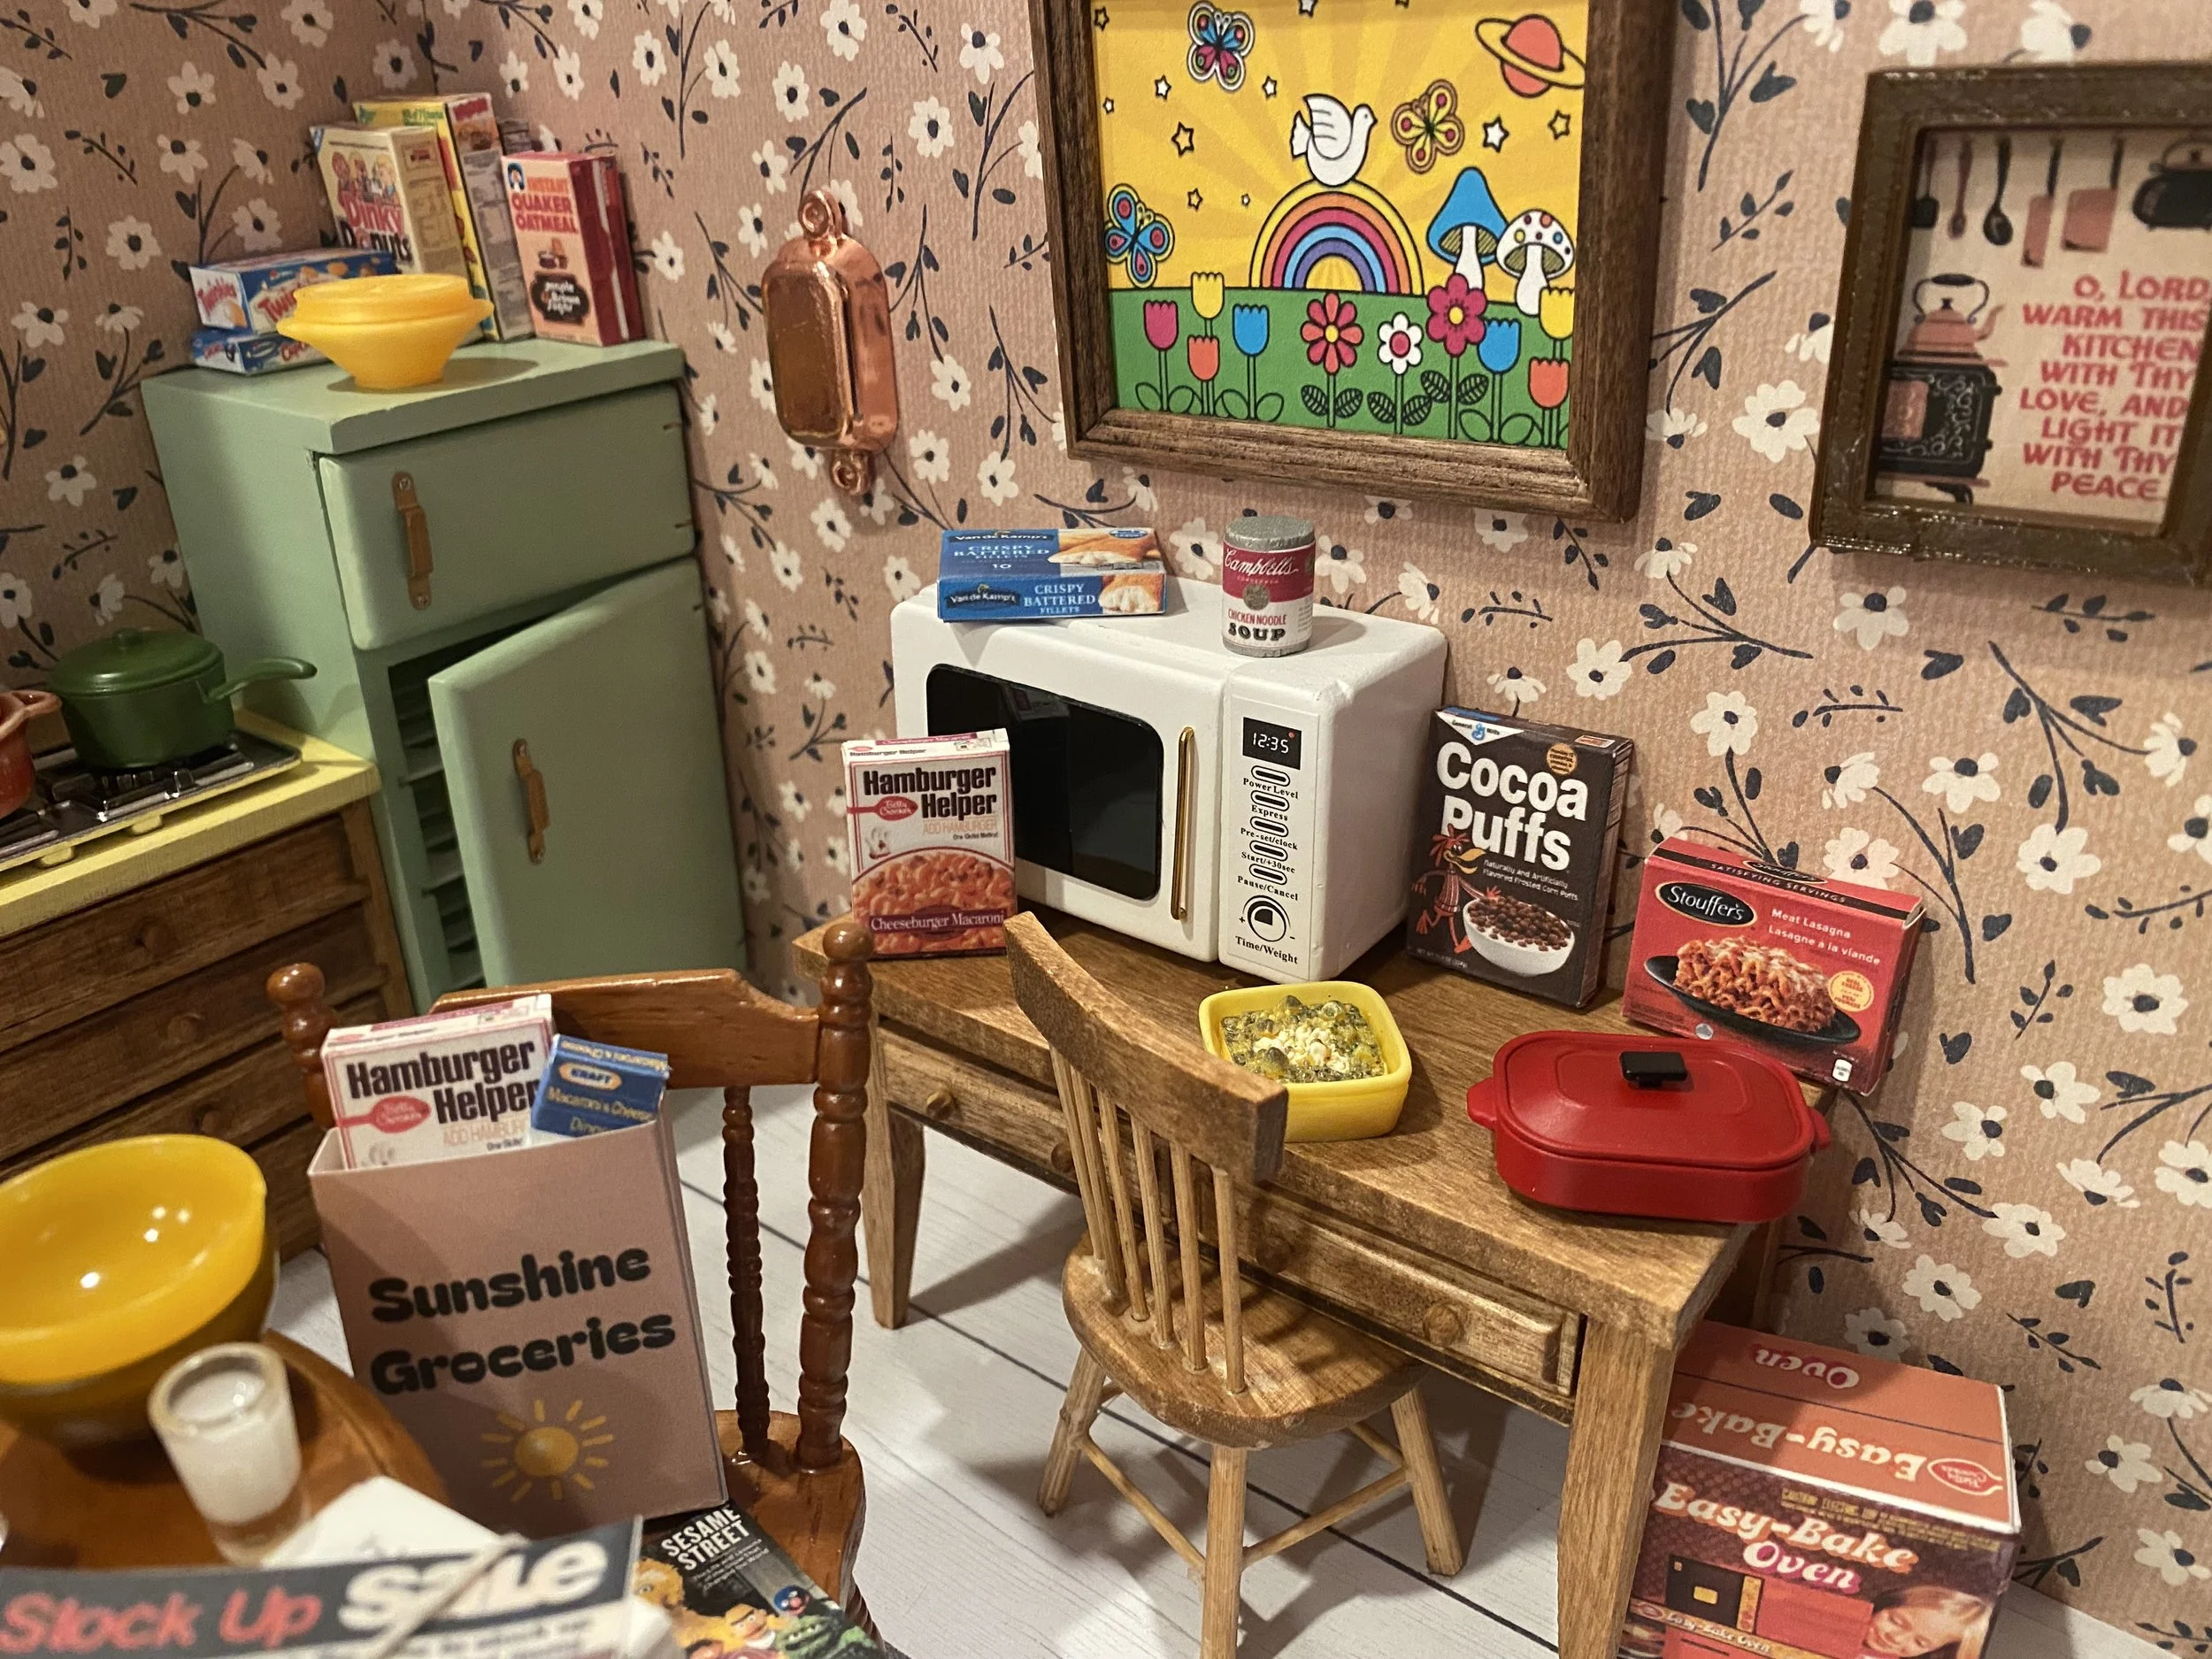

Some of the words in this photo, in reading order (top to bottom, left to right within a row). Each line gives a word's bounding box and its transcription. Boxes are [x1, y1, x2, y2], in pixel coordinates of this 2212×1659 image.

[511, 194, 572, 213] QUAKER
[515, 214, 579, 234] OATMEAL
[2074, 275, 2104, 303] O,
[2120, 270, 2211, 303] LORD,
[2022, 303, 2123, 329] WARM
[2142, 306, 2203, 333] THIS
[2062, 334, 2201, 362] KITCHEN
[2040, 360, 2118, 388] WITH
[2131, 360, 2194, 390] THY
[2020, 388, 2108, 418] LOVE,
[2121, 392, 2190, 419] AND
[2041, 417, 2140, 445] LIGHT
[2150, 422, 2184, 447] IT
[2022, 444, 2101, 470] WITH
[2115, 446, 2176, 475] THY
[2051, 472, 2164, 501] PEACE
[1225, 548, 1299, 576] Campbell's
[951, 594, 970, 603] Van
[1023, 595, 1096, 608] BATTERED
[1033, 584, 1085, 596] CRISPY
[1040, 606, 1080, 615] FILLETS
[1228, 608, 1256, 625] CHICKEN
[1256, 613, 1287, 626] NOODLE
[1227, 622, 1286, 641] SOUP
[1252, 731, 1290, 755] 12:35
[862, 766, 997, 796] Hamburger
[1242, 778, 1272, 794] Power
[1272, 786, 1300, 799] Level
[1436, 741, 1589, 822] Cocoa
[920, 791, 998, 822] Helper
[1250, 803, 1289, 822] Express
[943, 818, 998, 833] HAMBURGER
[1440, 795, 1571, 872] Puffs
[1483, 859, 1516, 874] Naturally
[1516, 867, 1532, 878] and
[1709, 863, 1781, 887] SATISFYING
[1785, 881, 1847, 904] SERVINGS
[1237, 875, 1300, 901] Pause/Cancel
[1514, 877, 1541, 890] Frosted
[1541, 884, 1560, 895] Corn
[1666, 885, 1747, 923] Stouffer's
[870, 914, 949, 932] Cheeseburger
[951, 909, 1005, 926] Macaroni
[1771, 908, 1801, 925] Meat
[1803, 917, 1852, 939] Lasagna
[1234, 935, 1299, 965] Time/Weight
[1768, 926, 1816, 947] Lasagne
[1827, 941, 1839, 953] la
[1841, 946, 1882, 965] viande
[346, 1041, 535, 1100] Hamburger
[571, 1068, 612, 1084] KRAFT
[433, 1078, 541, 1125] Helper
[367, 1247, 652, 1323] Sunshine
[369, 1314, 676, 1397] Groceries
[1755, 1349, 1860, 1389] Oven
[1671, 1402, 1927, 1483] Easy-Bake
[661, 1503, 741, 1557] SESAME
[1655, 1484, 1919, 1571] Easy-Bake
[677, 1519, 750, 1571] STREET
[1742, 1540, 1857, 1589] Oven
[0, 1591, 205, 1655] Stock
[219, 1586, 323, 1649] Up
